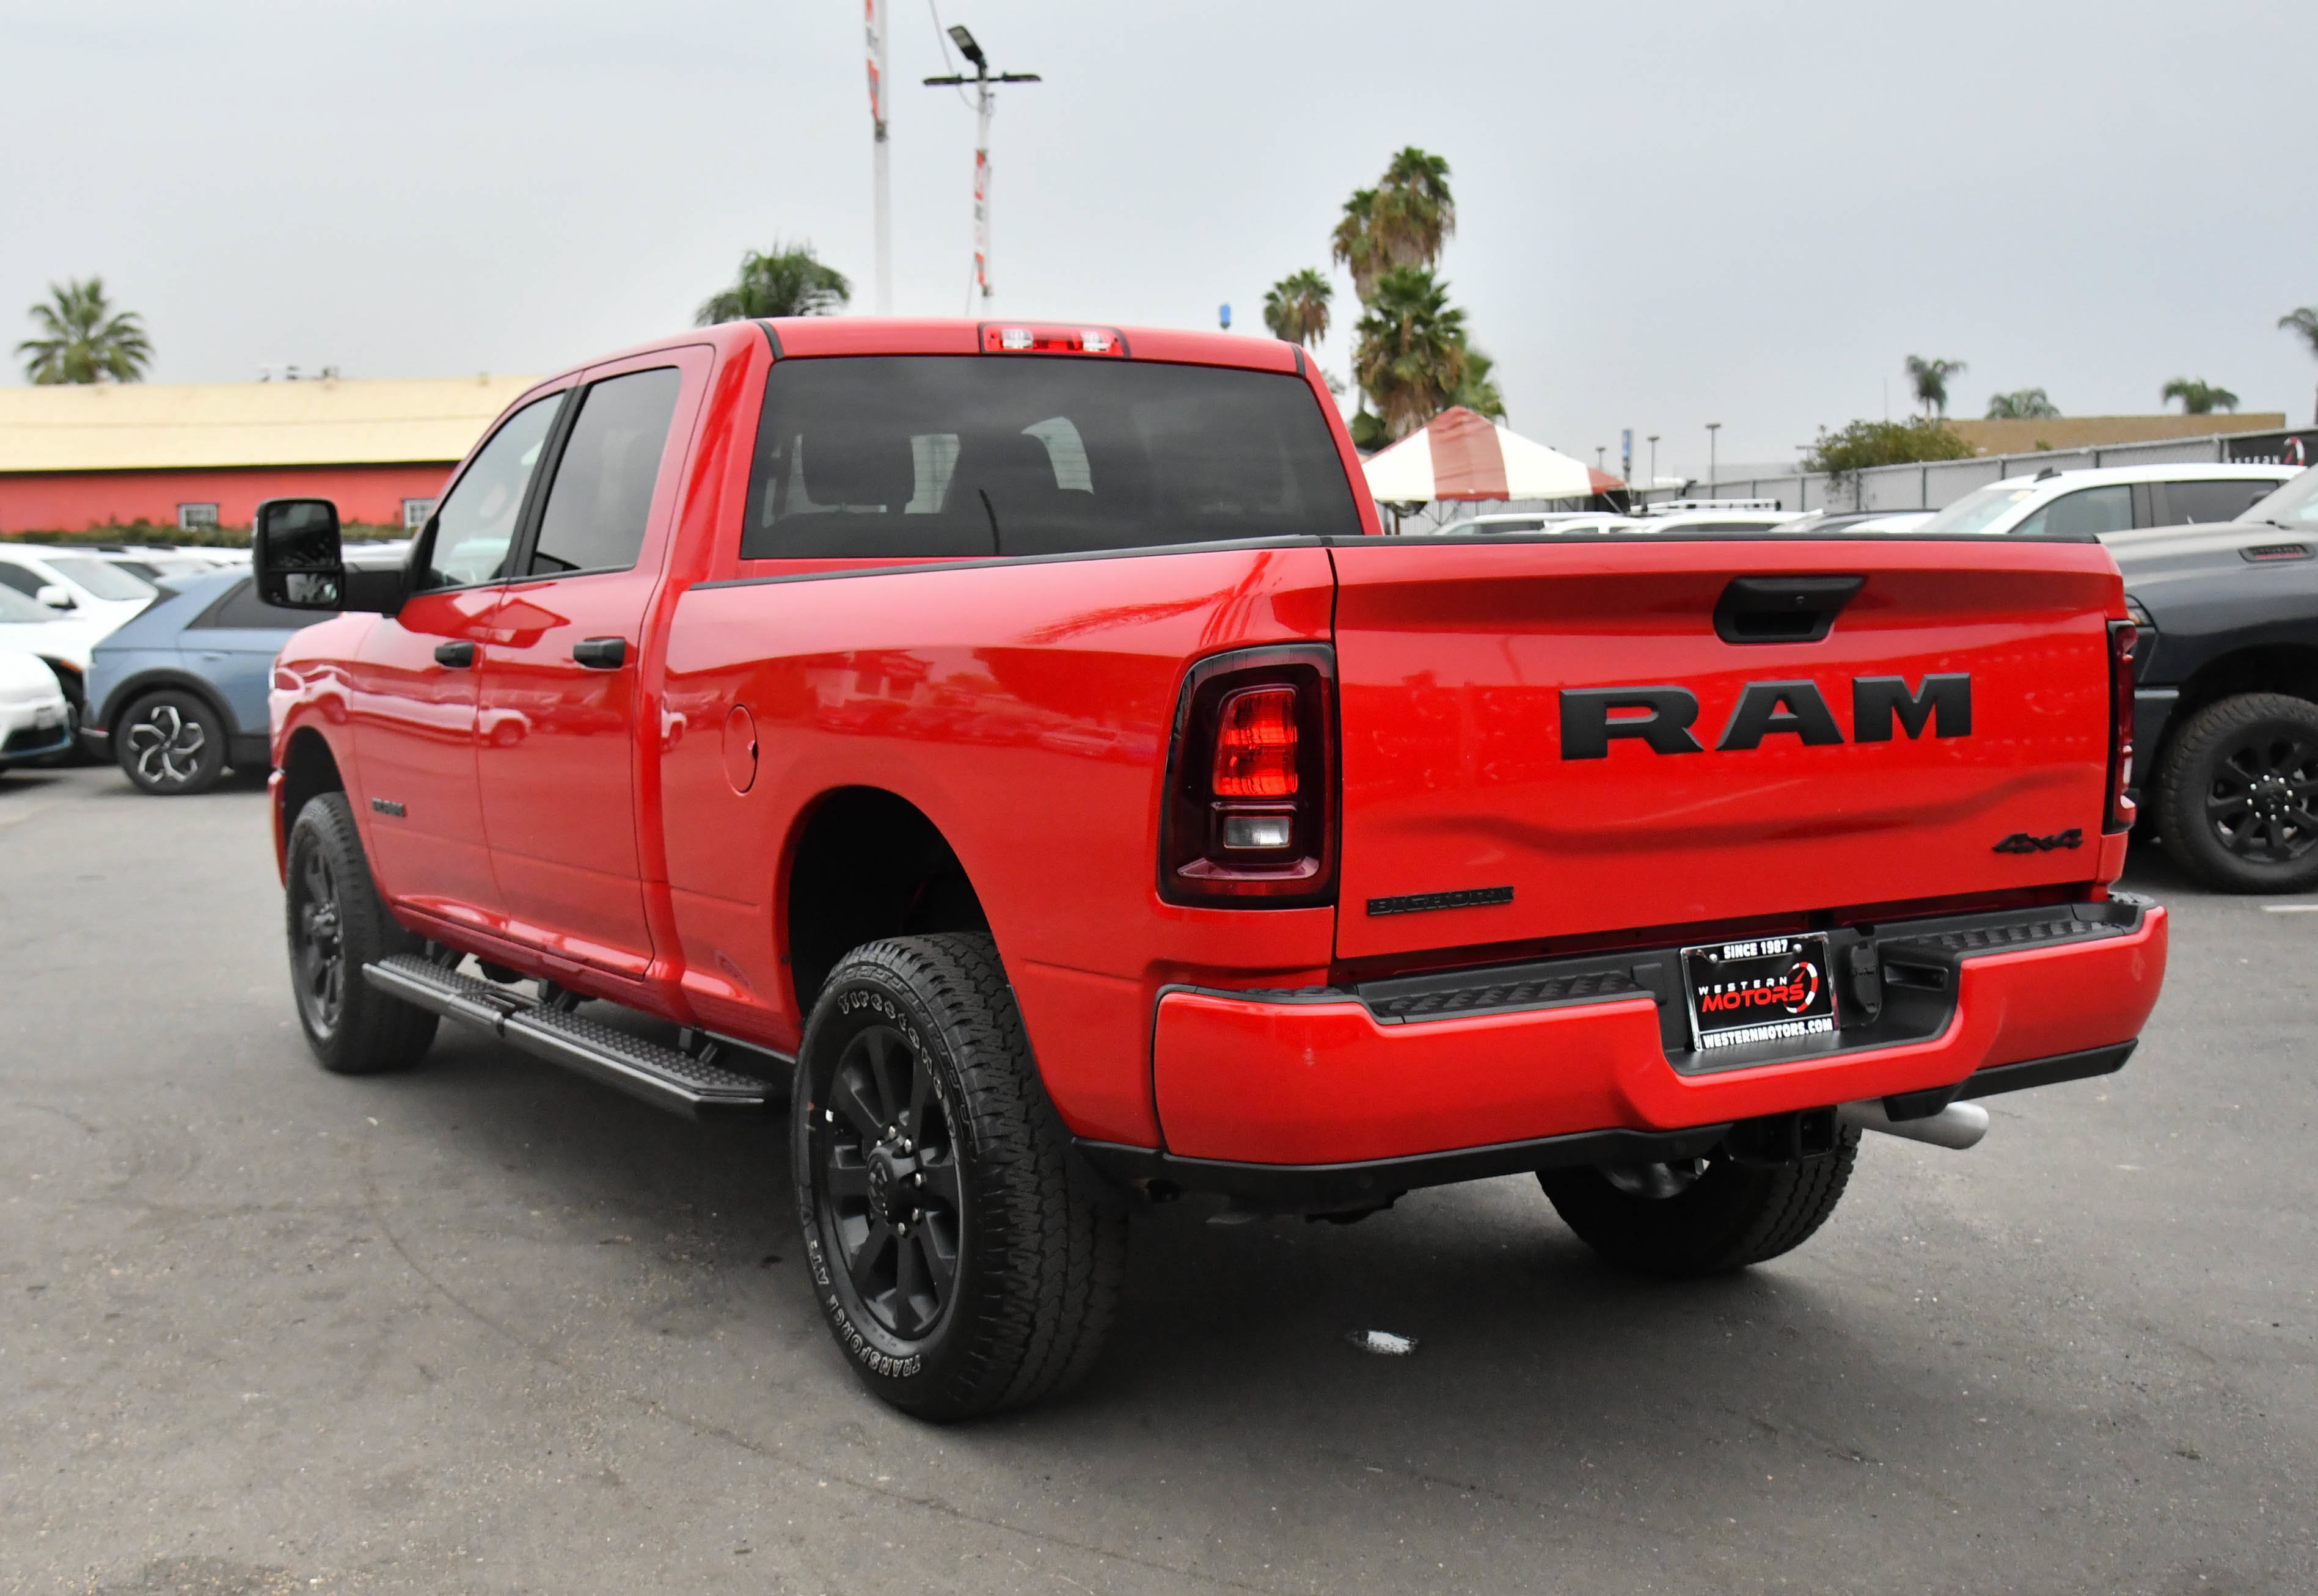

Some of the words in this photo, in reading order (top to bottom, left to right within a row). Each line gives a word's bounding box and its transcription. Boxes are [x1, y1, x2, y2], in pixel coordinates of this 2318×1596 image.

[1560, 672, 1972, 760] RAM
[1723, 942, 1758, 960] SINCE
[1760, 939, 1788, 955] 1987
[1698, 976, 1788, 995] WESTERN
[1701, 983, 1804, 1013] MOTORS
[1702, 1018, 1834, 1049] WESTERNMOTORS.COM
[827, 1293, 921, 1379] TRANSFORCE
